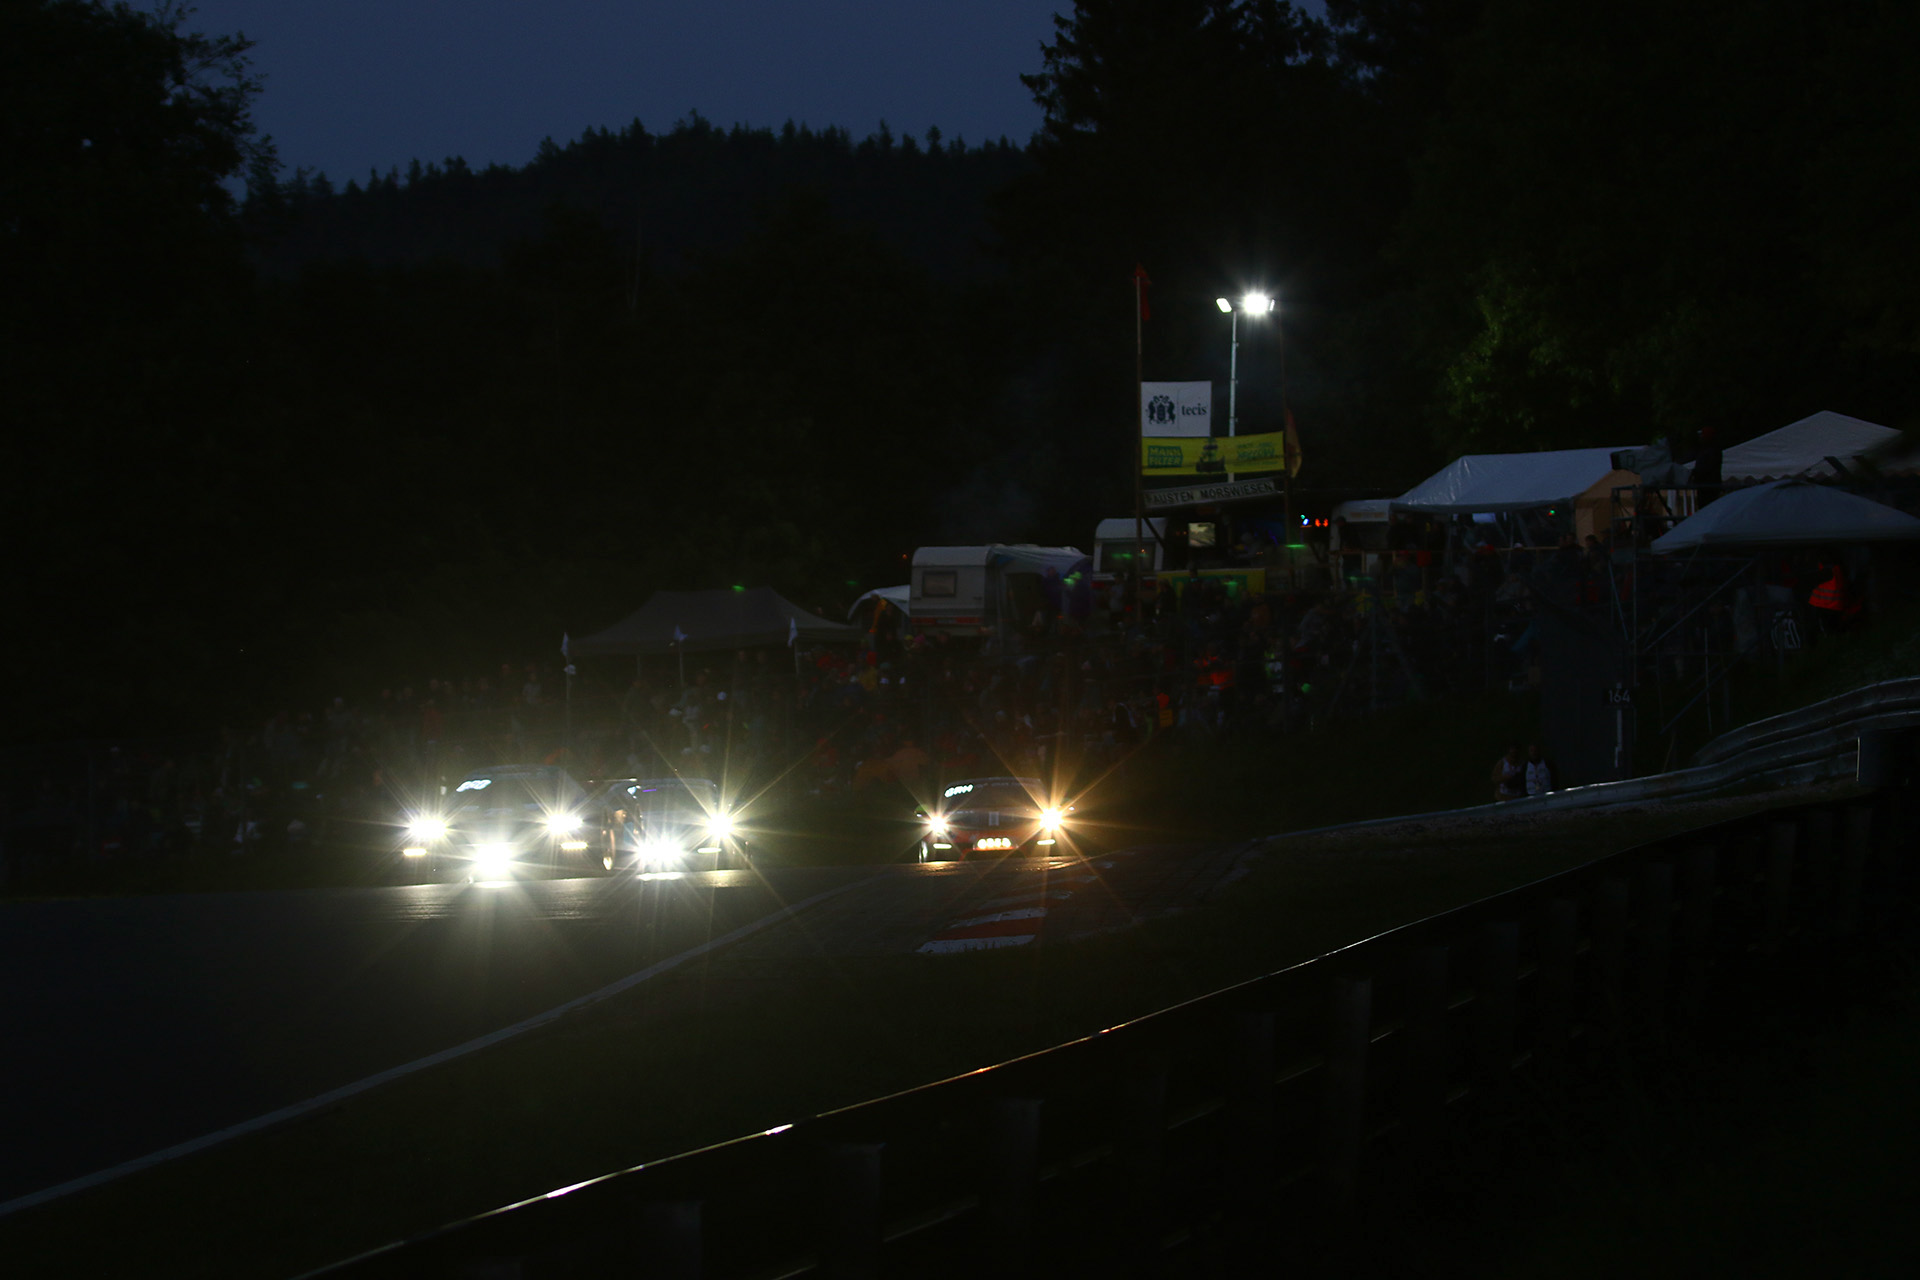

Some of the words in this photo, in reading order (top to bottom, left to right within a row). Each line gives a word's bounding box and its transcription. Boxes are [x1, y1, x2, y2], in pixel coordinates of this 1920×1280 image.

[1181, 403, 1207, 416] tecis
[1150, 447, 1182, 456] MANN
[1150, 457, 1182, 466] FILTER
[1608, 689, 1631, 703] 164
